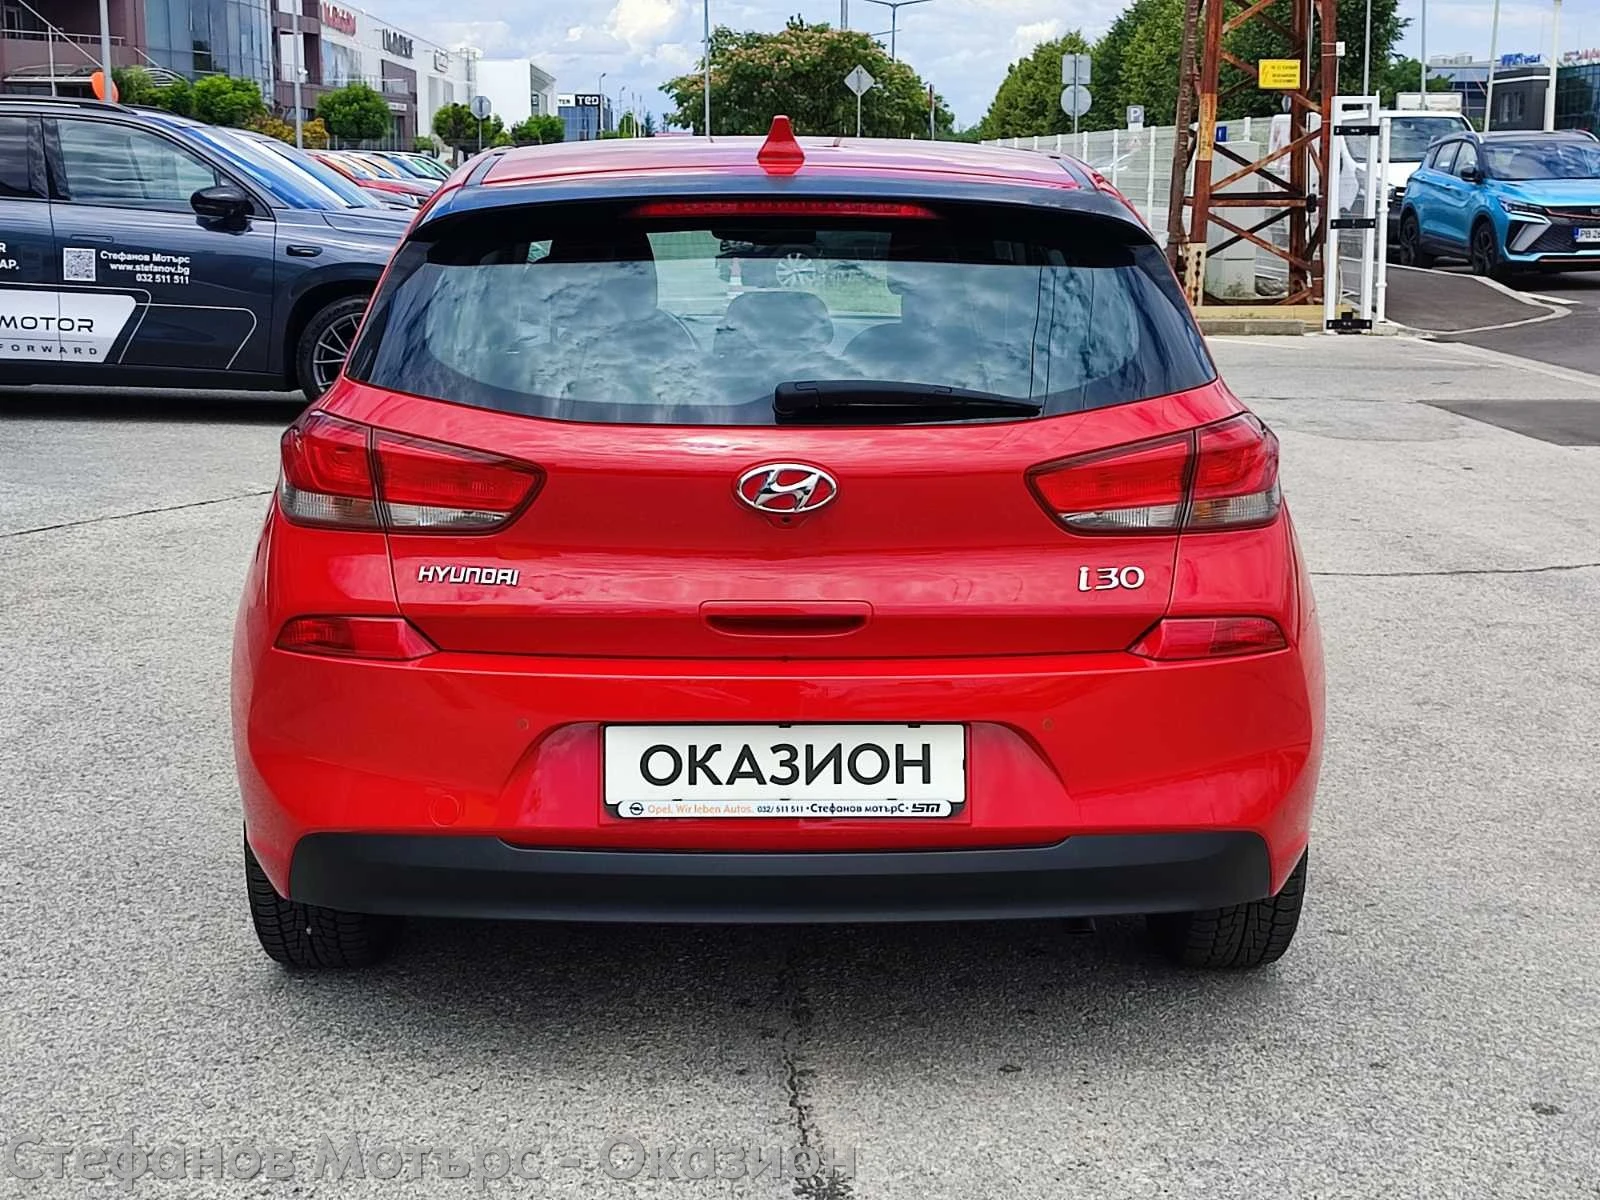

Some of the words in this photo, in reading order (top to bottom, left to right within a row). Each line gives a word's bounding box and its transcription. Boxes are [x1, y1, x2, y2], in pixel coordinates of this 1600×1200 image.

[1129, 107, 1140, 121] P
[100, 250, 150, 262] Стефанов
[152, 253, 190, 264] Мотърс
[109, 263, 190, 275] www.stefanov.bg
[136, 273, 153, 282] 032
[155, 274, 171, 284] 511
[173, 275, 189, 284] 511
[418, 565, 520, 586] HYUNDAI
[1078, 566, 1145, 591] i30
[639, 742, 931, 787] ОКАЗИОН
[776, 804, 789, 814] 511
[791, 804, 804, 814] 511
